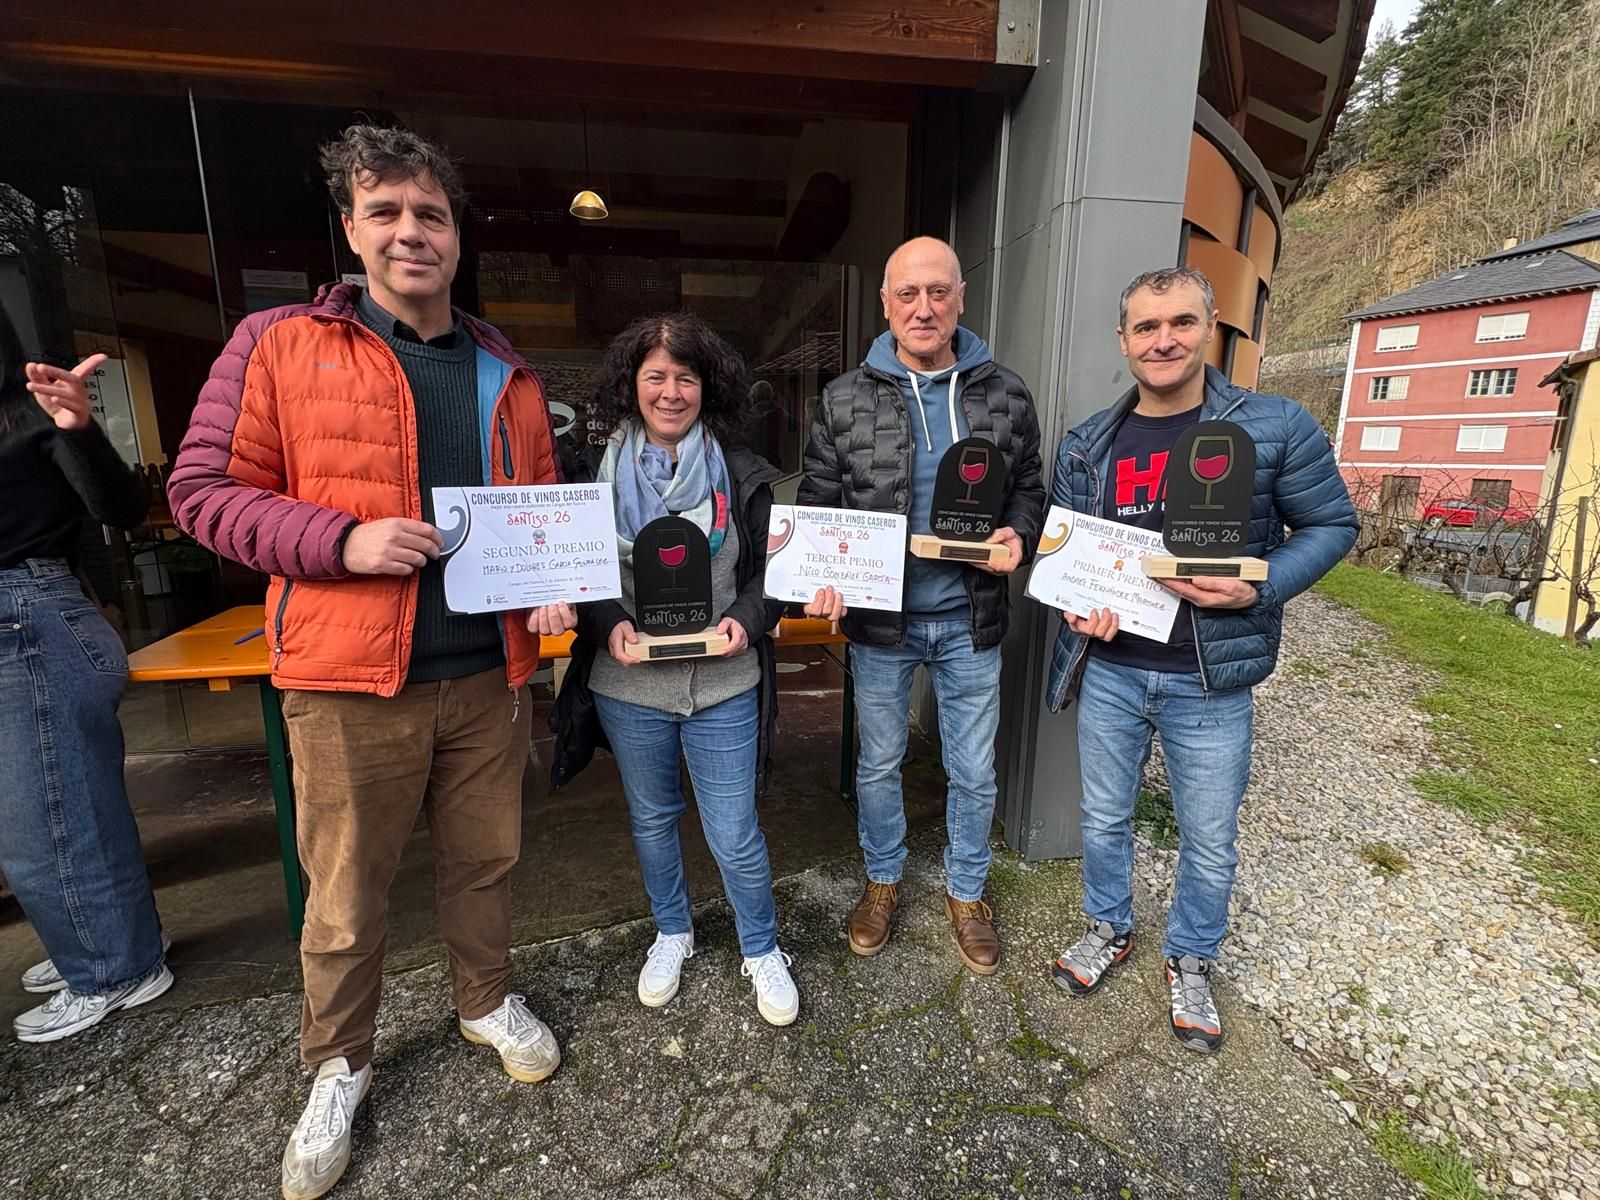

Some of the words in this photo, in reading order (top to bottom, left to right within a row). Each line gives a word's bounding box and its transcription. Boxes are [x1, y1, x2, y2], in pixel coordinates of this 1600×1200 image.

[471, 492, 518, 505] CONCURSO
[521, 492, 531, 504] DE
[534, 490, 560, 503] VINOS
[563, 489, 600, 501] CASEROS
[1117, 502, 1154, 516] HELLY
[554, 510, 571, 523] 26
[797, 511, 832, 522] CONCURSO
[835, 513, 843, 523] DE
[845, 514, 866, 525] VINOS
[867, 516, 897, 528] CASEROS
[975, 520, 990, 533] 26
[1075, 518, 1114, 536] CONCURSO
[1115, 528, 1125, 539] DE
[1127, 530, 1150, 545] VINOS
[857, 529, 869, 540] 26
[1221, 529, 1240, 543] 26
[483, 544, 550, 559] SEGUNDO
[553, 540, 605, 554] PREMIO
[805, 553, 847, 565] TERCER
[1073, 559, 1116, 580] PRIMER
[1117, 572, 1163, 593] PREMIO
[690, 609, 707, 622] 26
